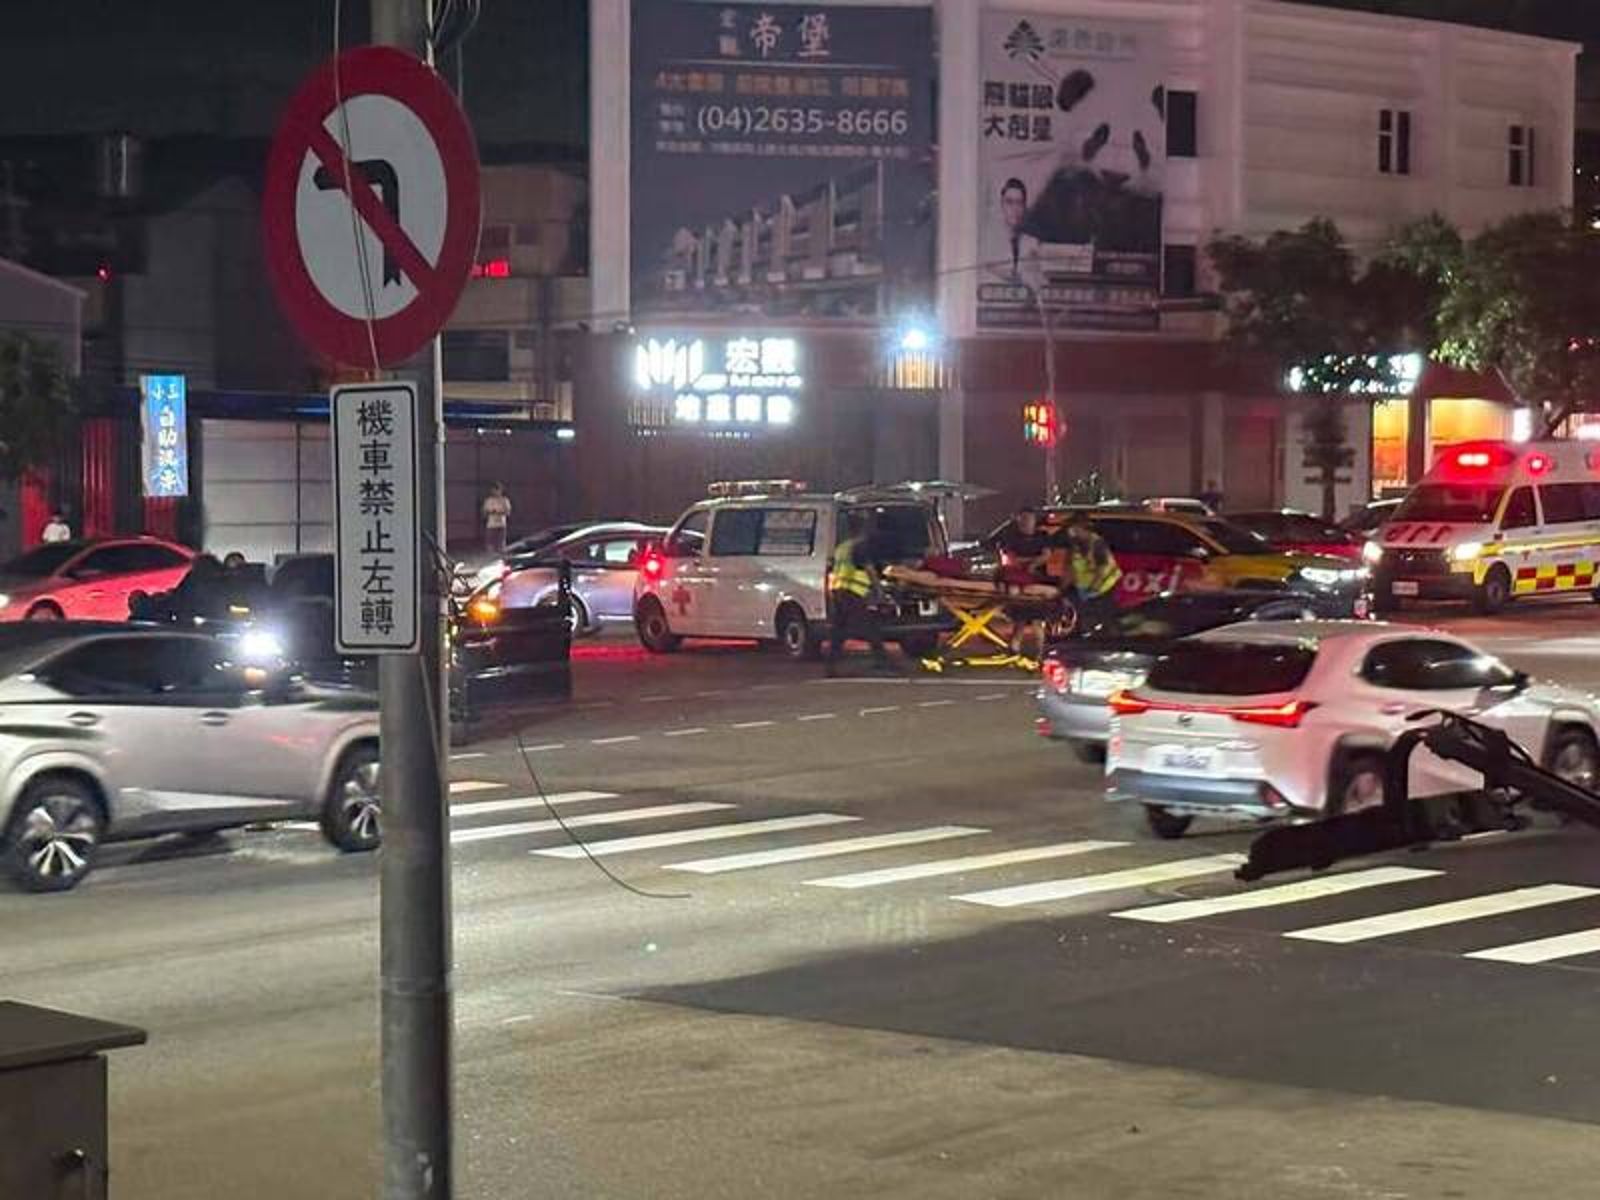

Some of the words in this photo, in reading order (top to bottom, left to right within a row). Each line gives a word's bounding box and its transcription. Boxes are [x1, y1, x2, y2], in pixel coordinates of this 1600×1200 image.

[750, 13, 831, 57] 帝堡
[697, 104, 908, 135] (04)2635-8666
[356, 399, 395, 636] 機車禁止左轉
[1121, 563, 1183, 594] oxi
